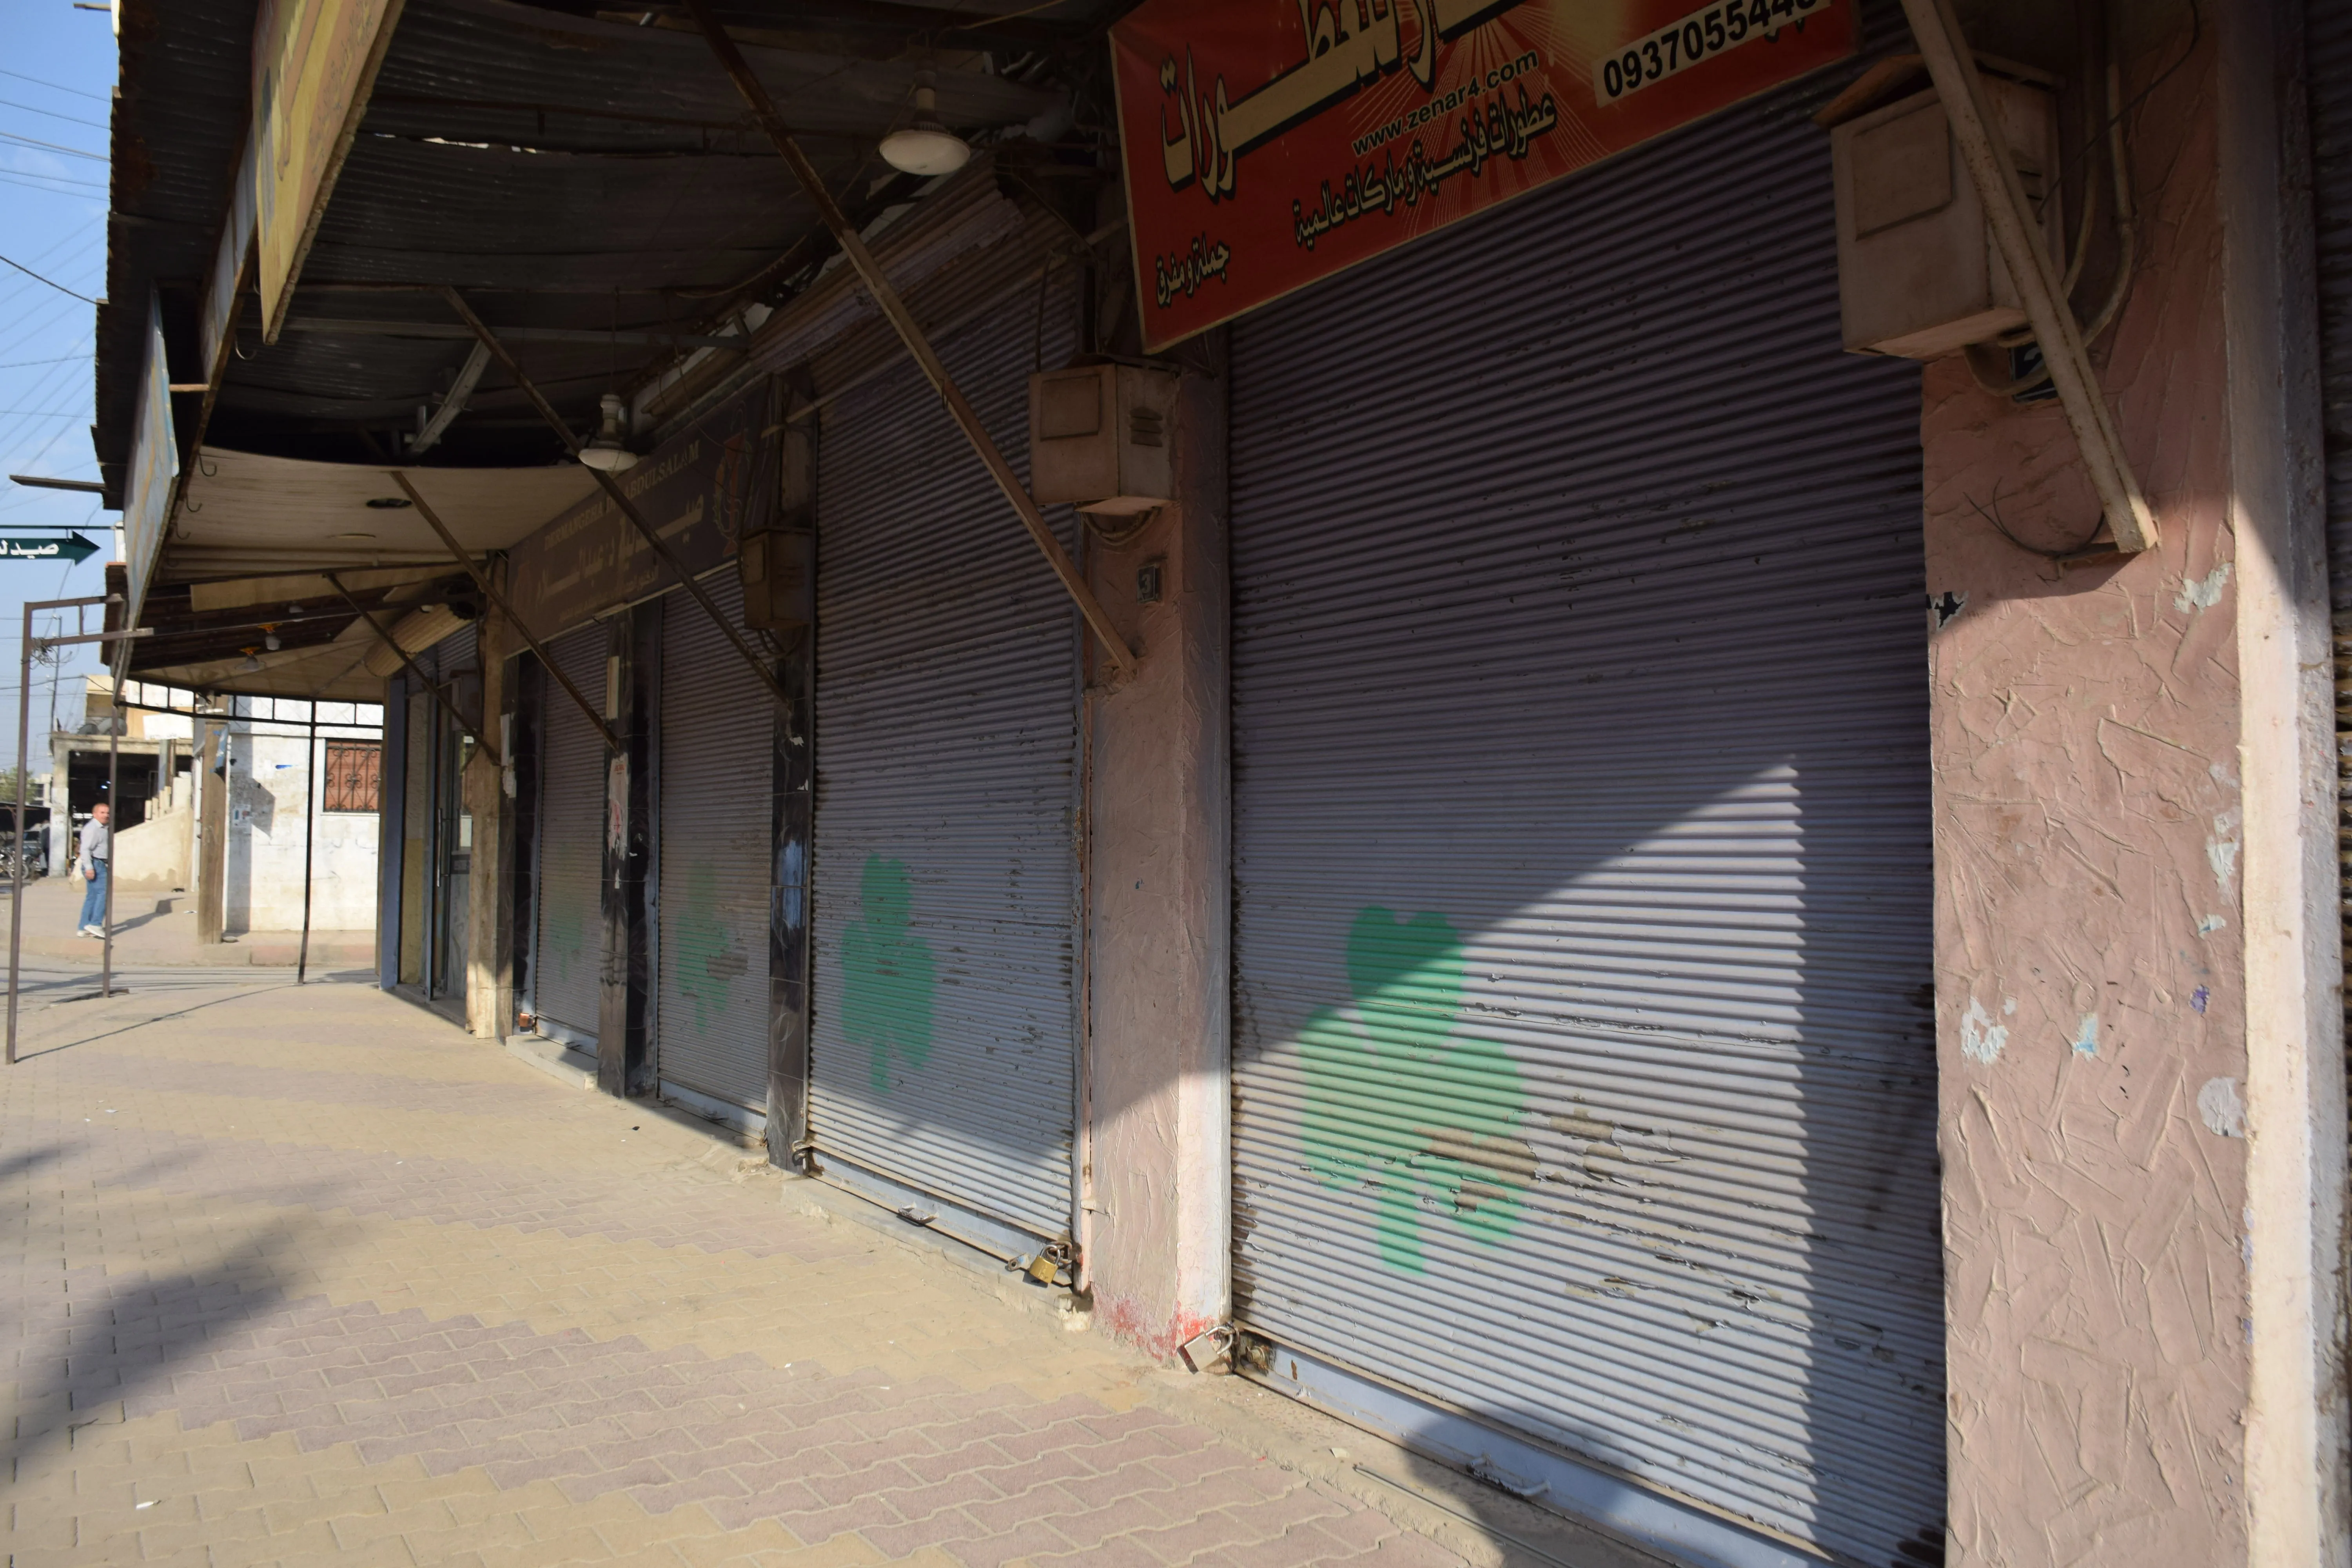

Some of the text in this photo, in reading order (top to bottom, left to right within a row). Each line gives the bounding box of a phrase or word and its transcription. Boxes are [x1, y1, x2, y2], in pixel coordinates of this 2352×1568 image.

[1352, 50, 1539, 156] www.zenar4.com
[1489, 83, 1557, 159] عطورات
[1414, 107, 1490, 196] فرنسية
[1293, 180, 1347, 250] عالمية
[1192, 230, 1230, 289] جملة
[624, 439, 701, 501] ABDULSALAM
[0, 539, 60, 559] صيدل
[1141, 573, 1151, 593] 3
